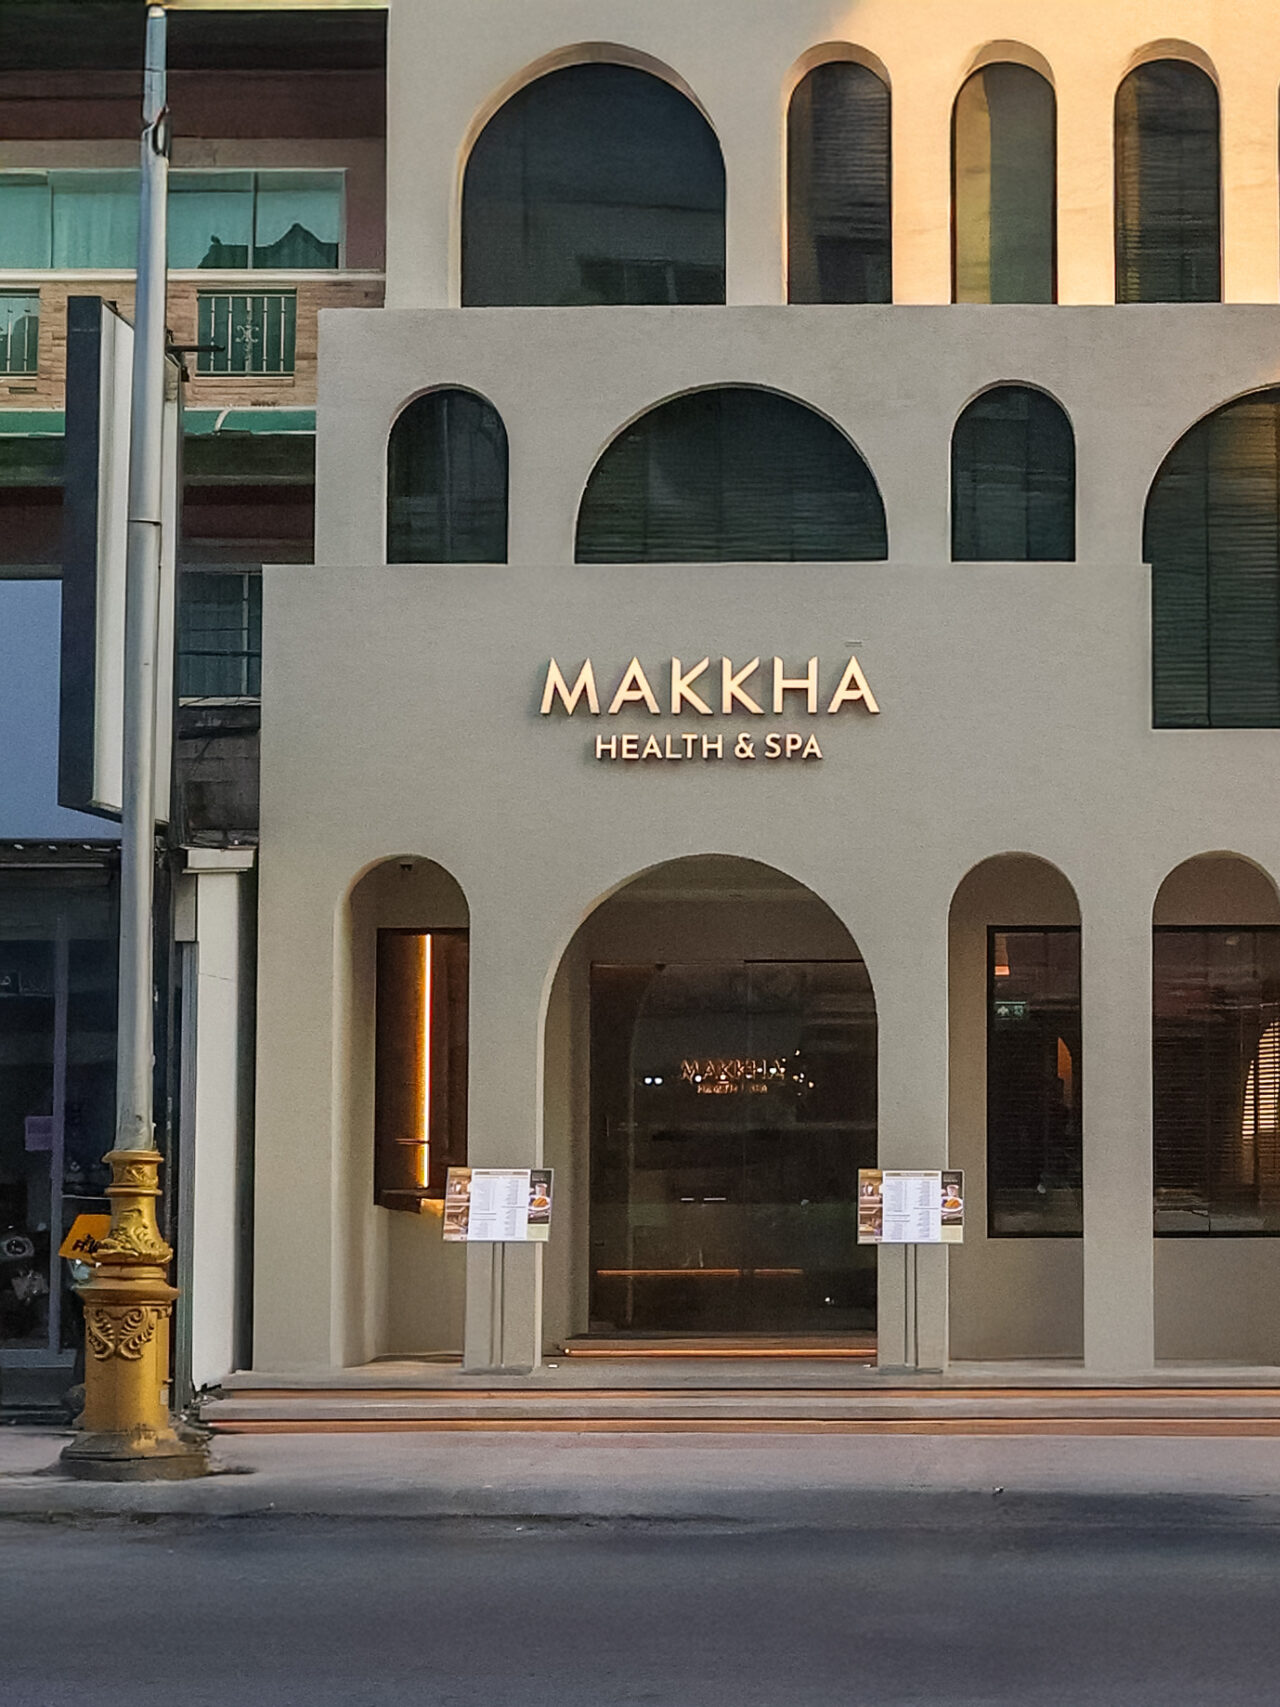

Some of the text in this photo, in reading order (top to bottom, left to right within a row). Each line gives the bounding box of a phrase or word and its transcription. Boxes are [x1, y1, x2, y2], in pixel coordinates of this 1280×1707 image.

[540, 656, 880, 715] MAKKHA
[595, 732, 823, 759] HEALTH & SPA
